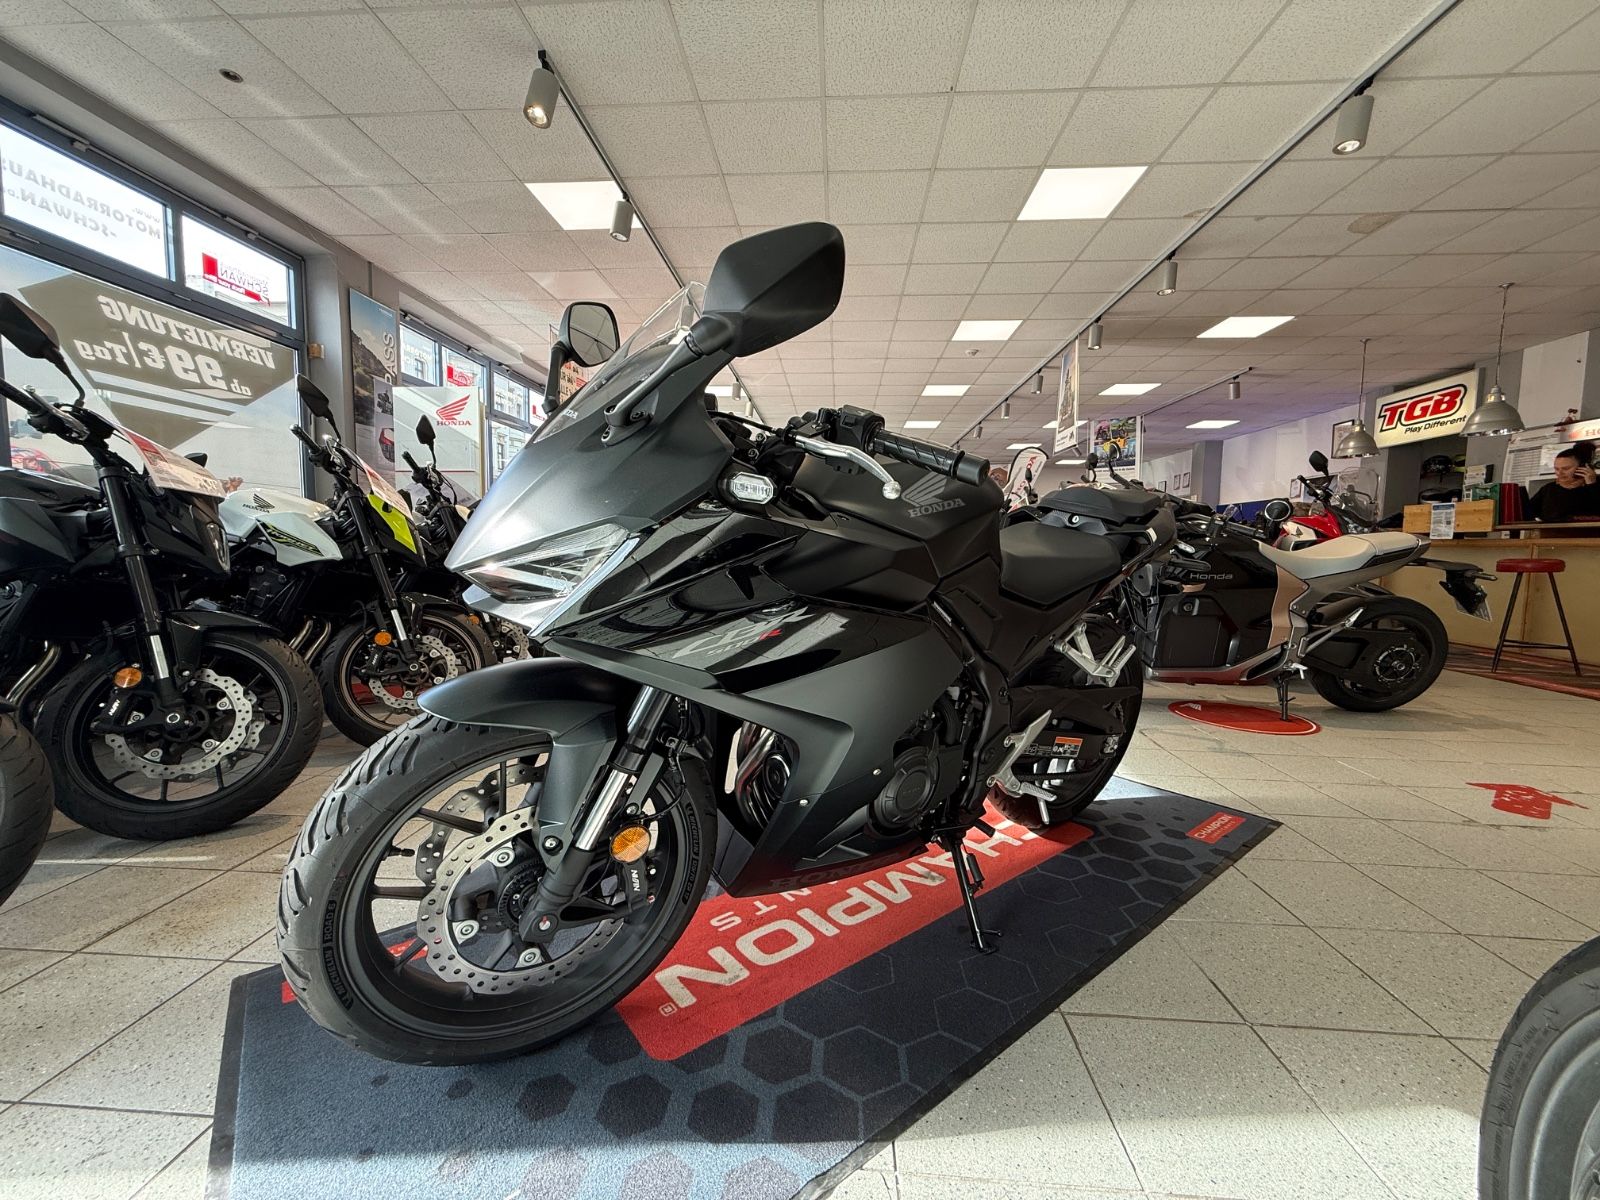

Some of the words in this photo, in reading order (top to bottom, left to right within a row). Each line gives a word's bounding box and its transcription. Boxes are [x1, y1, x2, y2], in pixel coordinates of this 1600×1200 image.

[1381, 387, 1464, 430] TGB
[1404, 425, 1423, 434] Play
[1424, 415, 1467, 430] Different
[242, 503, 270, 513] HONDA
[907, 498, 966, 518] HONDA
[689, 815, 700, 854] MICHELIN
[324, 912, 334, 941] ROAD
[324, 950, 346, 995] MICHELIN
